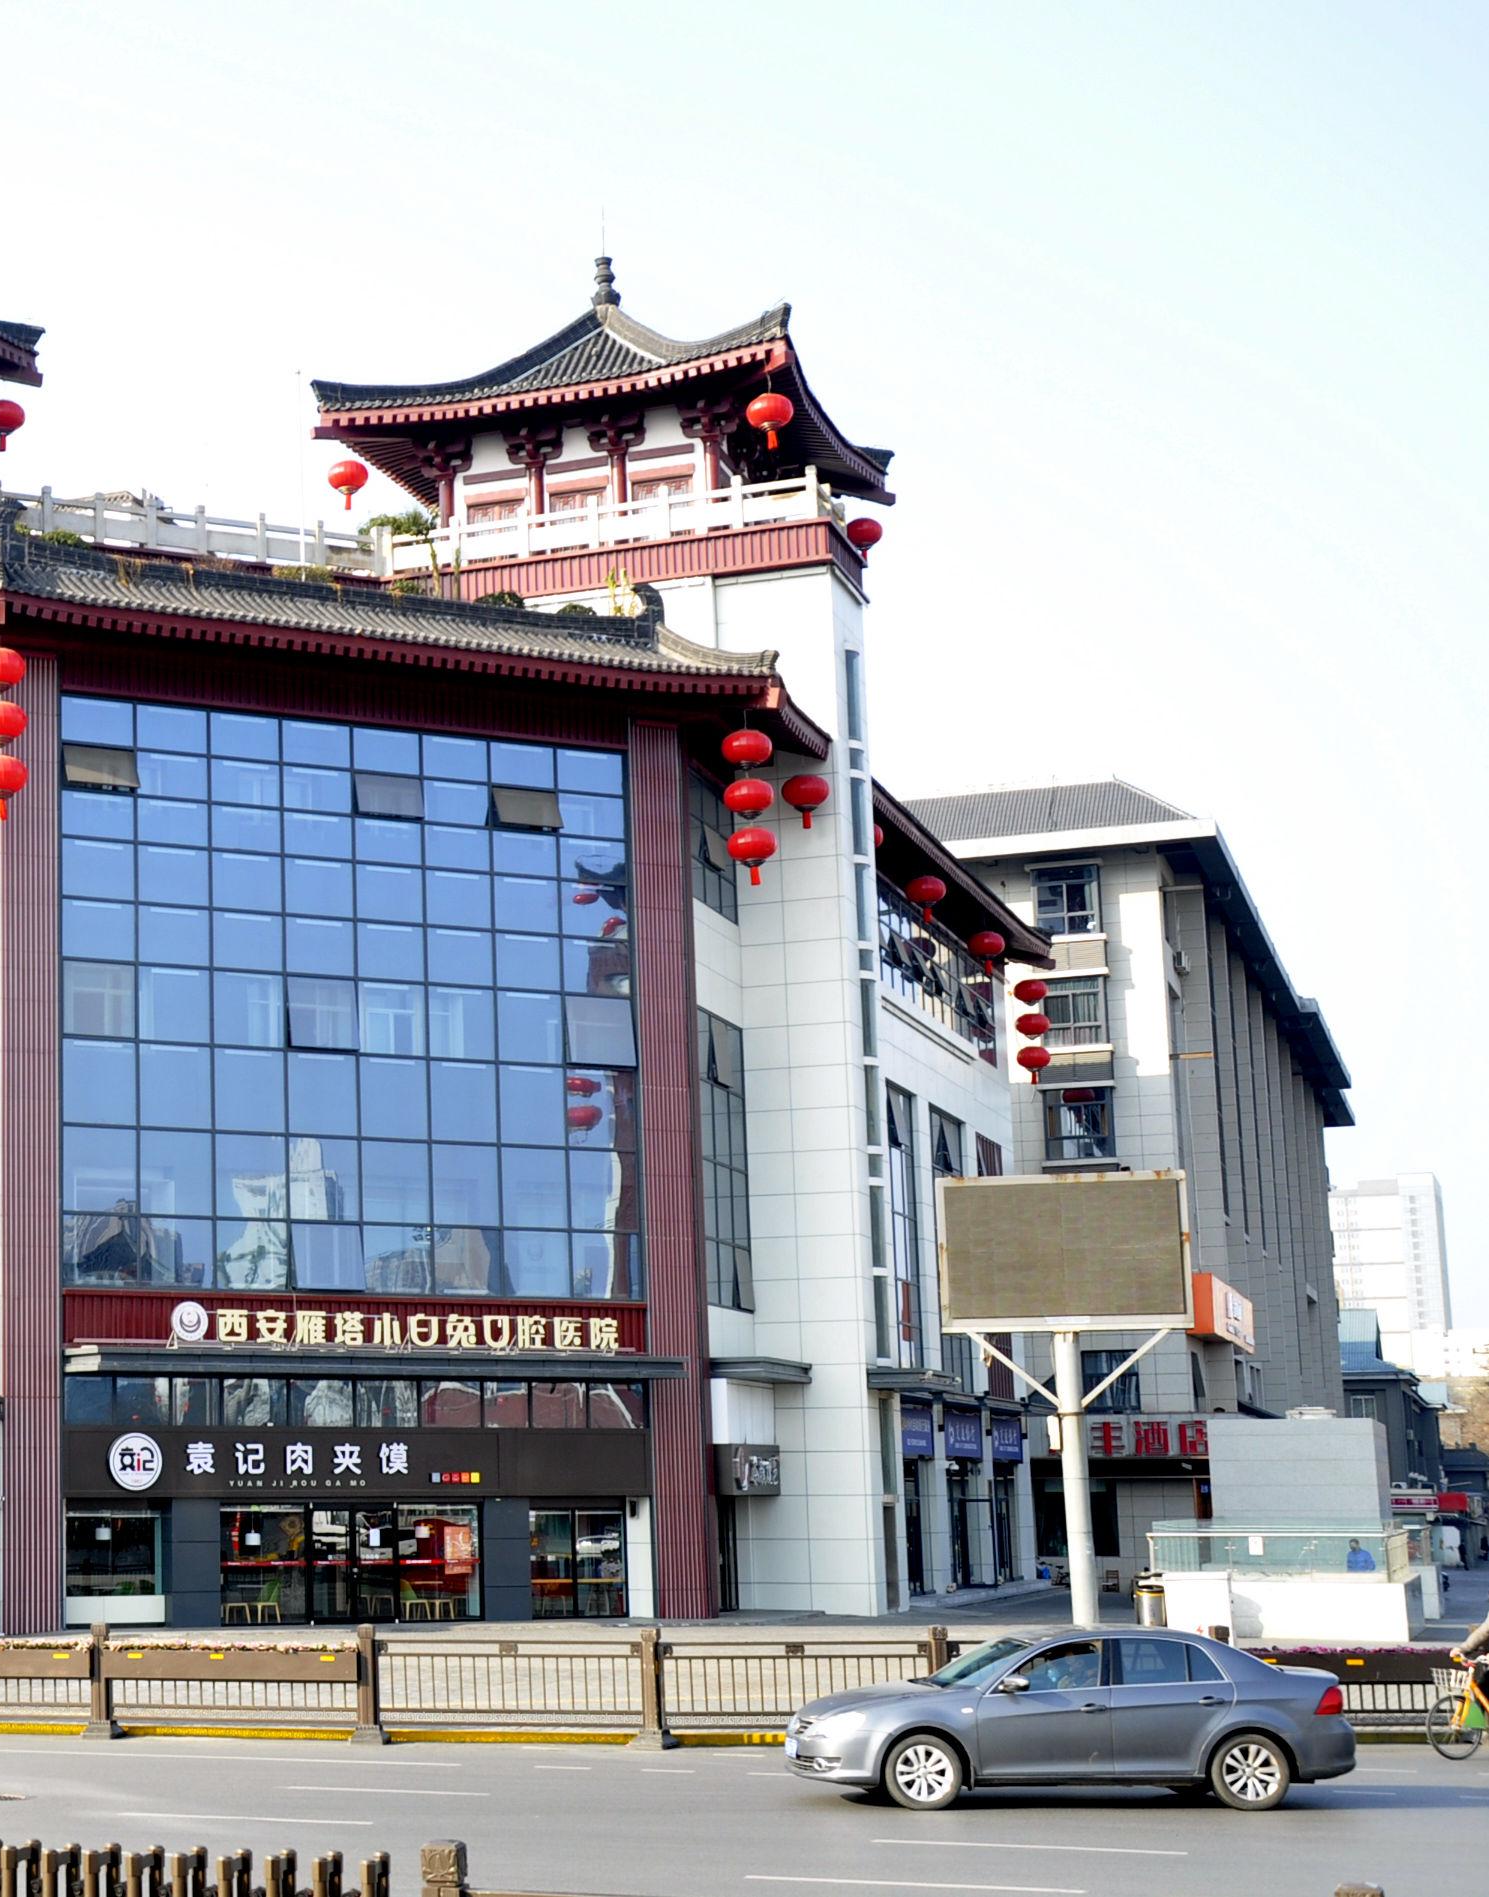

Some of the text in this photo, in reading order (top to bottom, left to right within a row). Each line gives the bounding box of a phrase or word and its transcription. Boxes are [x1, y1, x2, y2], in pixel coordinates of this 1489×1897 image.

[216, 1309, 619, 1350] 西安雁塔小白兔口腔医院
[185, 1441, 409, 1476] 袁记肉夹馍
